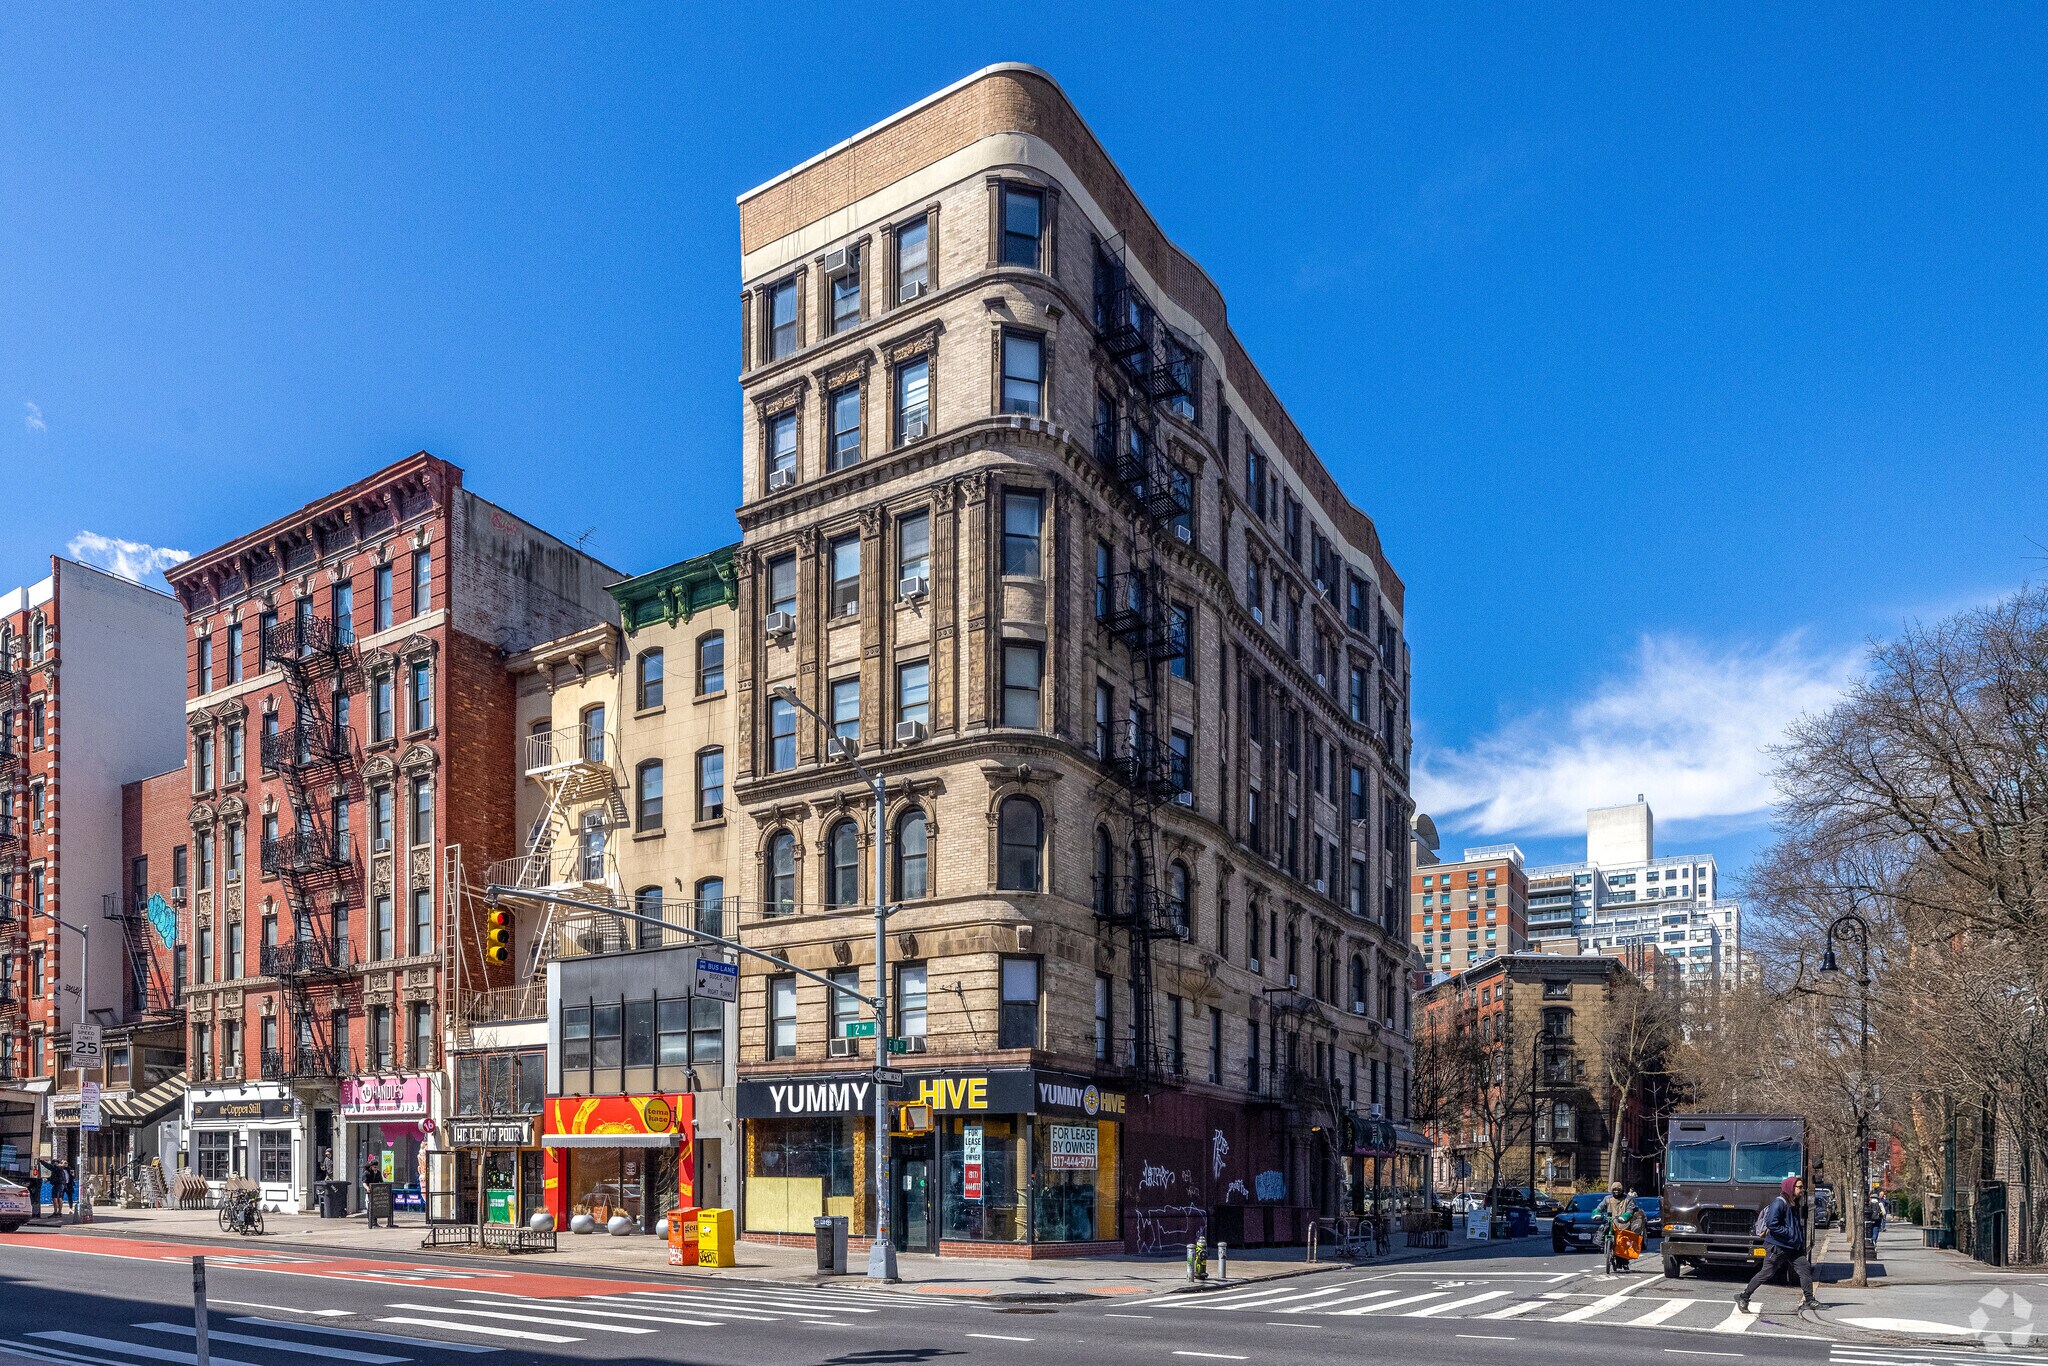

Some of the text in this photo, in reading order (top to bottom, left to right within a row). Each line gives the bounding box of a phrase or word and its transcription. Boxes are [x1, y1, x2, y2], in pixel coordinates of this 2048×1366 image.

[707, 963, 736, 974] BUS LANE
[855, 1024, 860, 1035] 2
[76, 1041, 98, 1054] 25
[888, 1039, 892, 1051] E
[893, 1040, 899, 1052] 10
[876, 1071, 887, 1080] ONE
[362, 1085, 403, 1101] 16 HANDLES
[769, 1078, 988, 1113] YUMMY HIVE
[1039, 1082, 1126, 1114] YUMMY HIVE
[219, 1103, 261, 1116] the Copper Still
[648, 1108, 669, 1116] tema
[423, 1120, 434, 1131] 16
[648, 1115, 668, 1123] kase
[454, 1124, 469, 1142] THE
[498, 1126, 521, 1142] POUR
[968, 1129, 979, 1137] FOR
[1052, 1127, 1096, 1141] FOR LEASE
[965, 1137, 982, 1146] LEASE
[1052, 1140, 1096, 1154] BY OWNER
